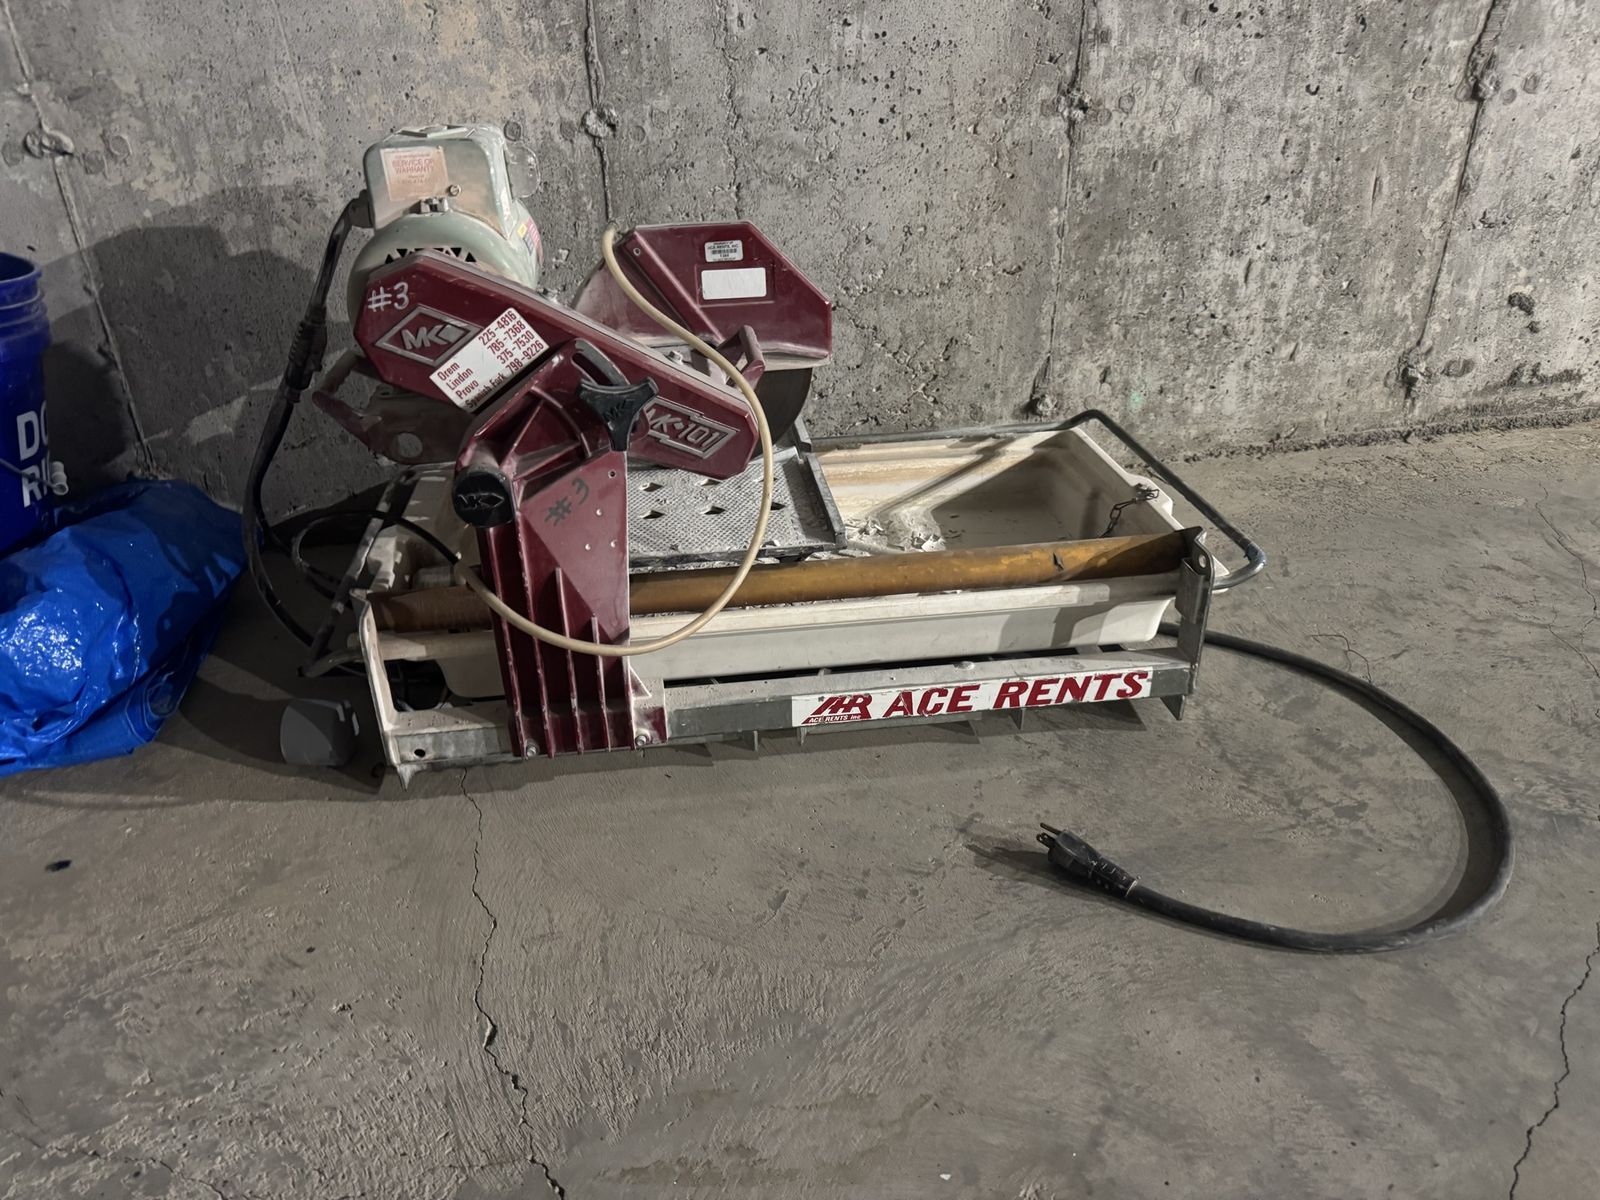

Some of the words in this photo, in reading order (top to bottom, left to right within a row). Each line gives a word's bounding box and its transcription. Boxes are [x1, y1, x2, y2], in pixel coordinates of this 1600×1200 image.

[368, 281, 409, 312] #3
[401, 326, 448, 350] MK
[437, 362, 460, 381] Orem
[478, 310, 517, 346] 225-4816
[445, 368, 474, 391] Lindon
[487, 320, 526, 355] 785-7368
[455, 380, 479, 400] Provo
[496, 330, 535, 365] 375-7530
[465, 385, 492, 409] Spanish
[489, 372, 505, 387] Fork
[505, 340, 544, 375] 798-9226
[544, 477, 590, 526] #3
[882, 683, 982, 718] ACE
[992, 670, 1149, 710] RENTS
